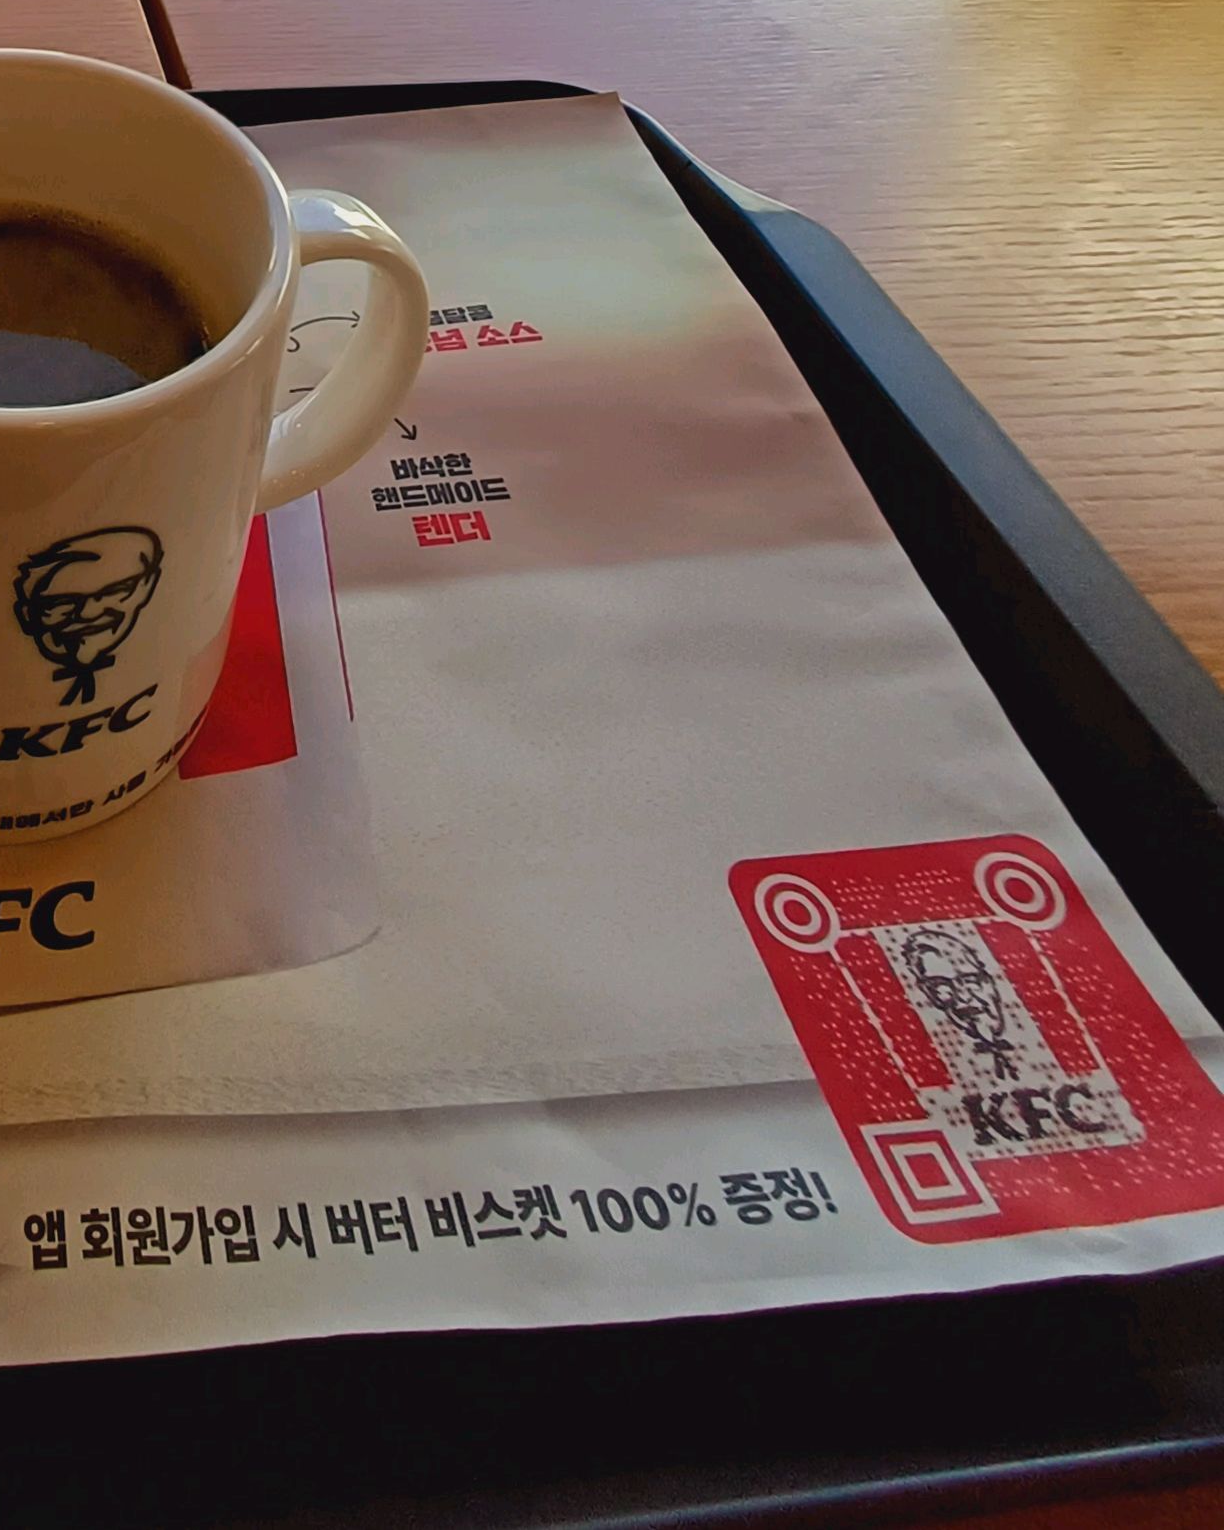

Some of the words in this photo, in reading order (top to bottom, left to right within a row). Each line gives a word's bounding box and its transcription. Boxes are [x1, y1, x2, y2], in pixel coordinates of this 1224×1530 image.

[424, 328, 468, 353] 념
[477, 321, 543, 347] 소스
[390, 453, 473, 480] 바삭한
[371, 478, 511, 511] 핸드메이드
[411, 511, 491, 547] 텐더
[962, 1083, 1110, 1146] KFC
[23, 1209, 68, 1270] 앱
[79, 1205, 260, 1267] 회원가입
[272, 1202, 317, 1259] 시
[325, 1197, 419, 1255] 버터
[424, 1184, 567, 1248] 비스켓
[569, 1182, 717, 1234] 100%
[719, 1167, 838, 1225] 증정!
